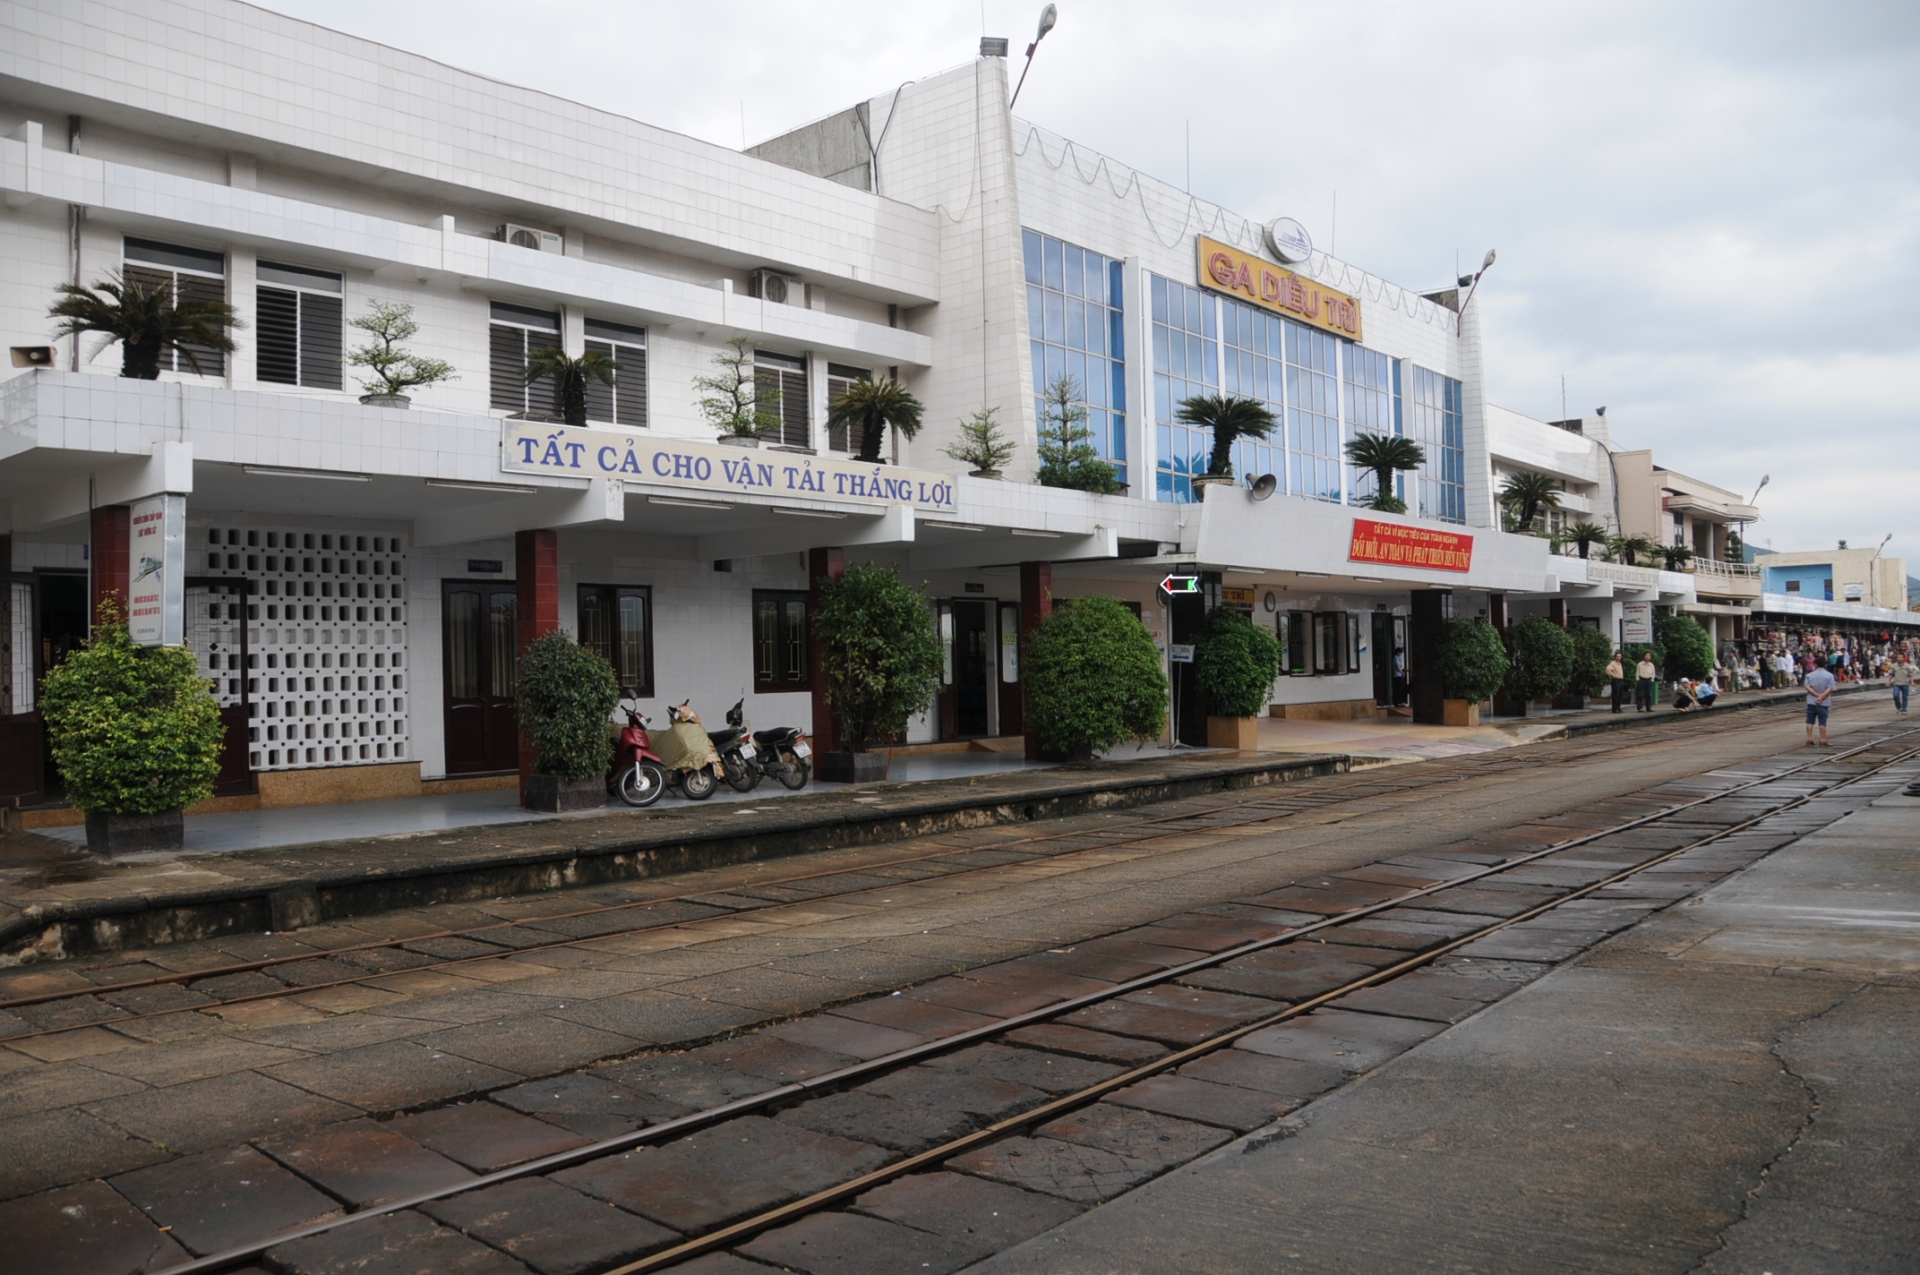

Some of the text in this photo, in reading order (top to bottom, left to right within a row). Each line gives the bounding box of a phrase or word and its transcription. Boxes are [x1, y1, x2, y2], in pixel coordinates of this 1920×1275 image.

[1209, 252, 1256, 296] GA
[1324, 295, 1358, 333] TRÌ
[517, 430, 952, 508] TẤT CẢ CHO VẬN TẢI THẮNG LỢI
[1374, 523, 1384, 534] TẤT
[1384, 525, 1391, 535] CẢ
